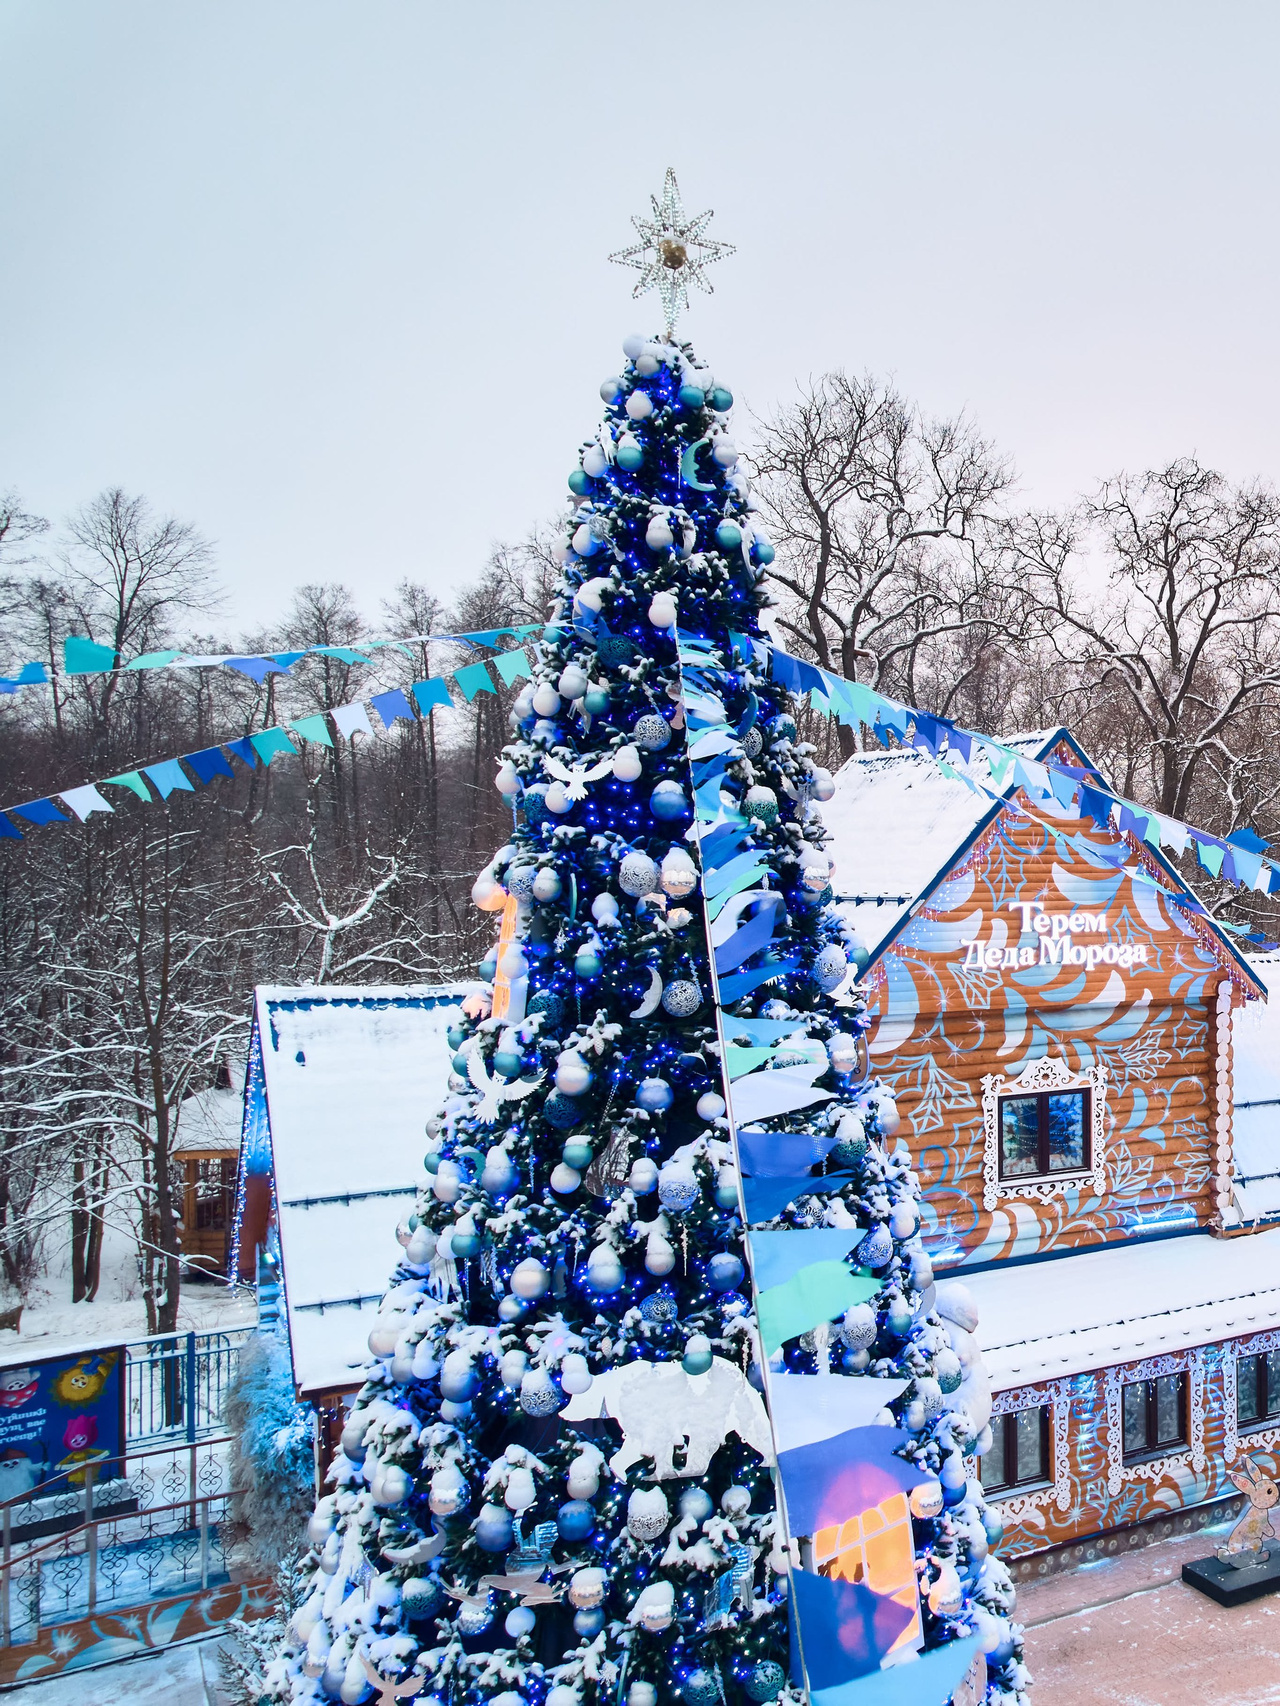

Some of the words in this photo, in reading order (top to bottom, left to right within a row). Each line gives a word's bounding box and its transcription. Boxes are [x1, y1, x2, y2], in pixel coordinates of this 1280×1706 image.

[1008, 901, 1107, 940] Терем
[960, 938, 1037, 973] Деда
[1038, 935, 1149, 971] Мороза
